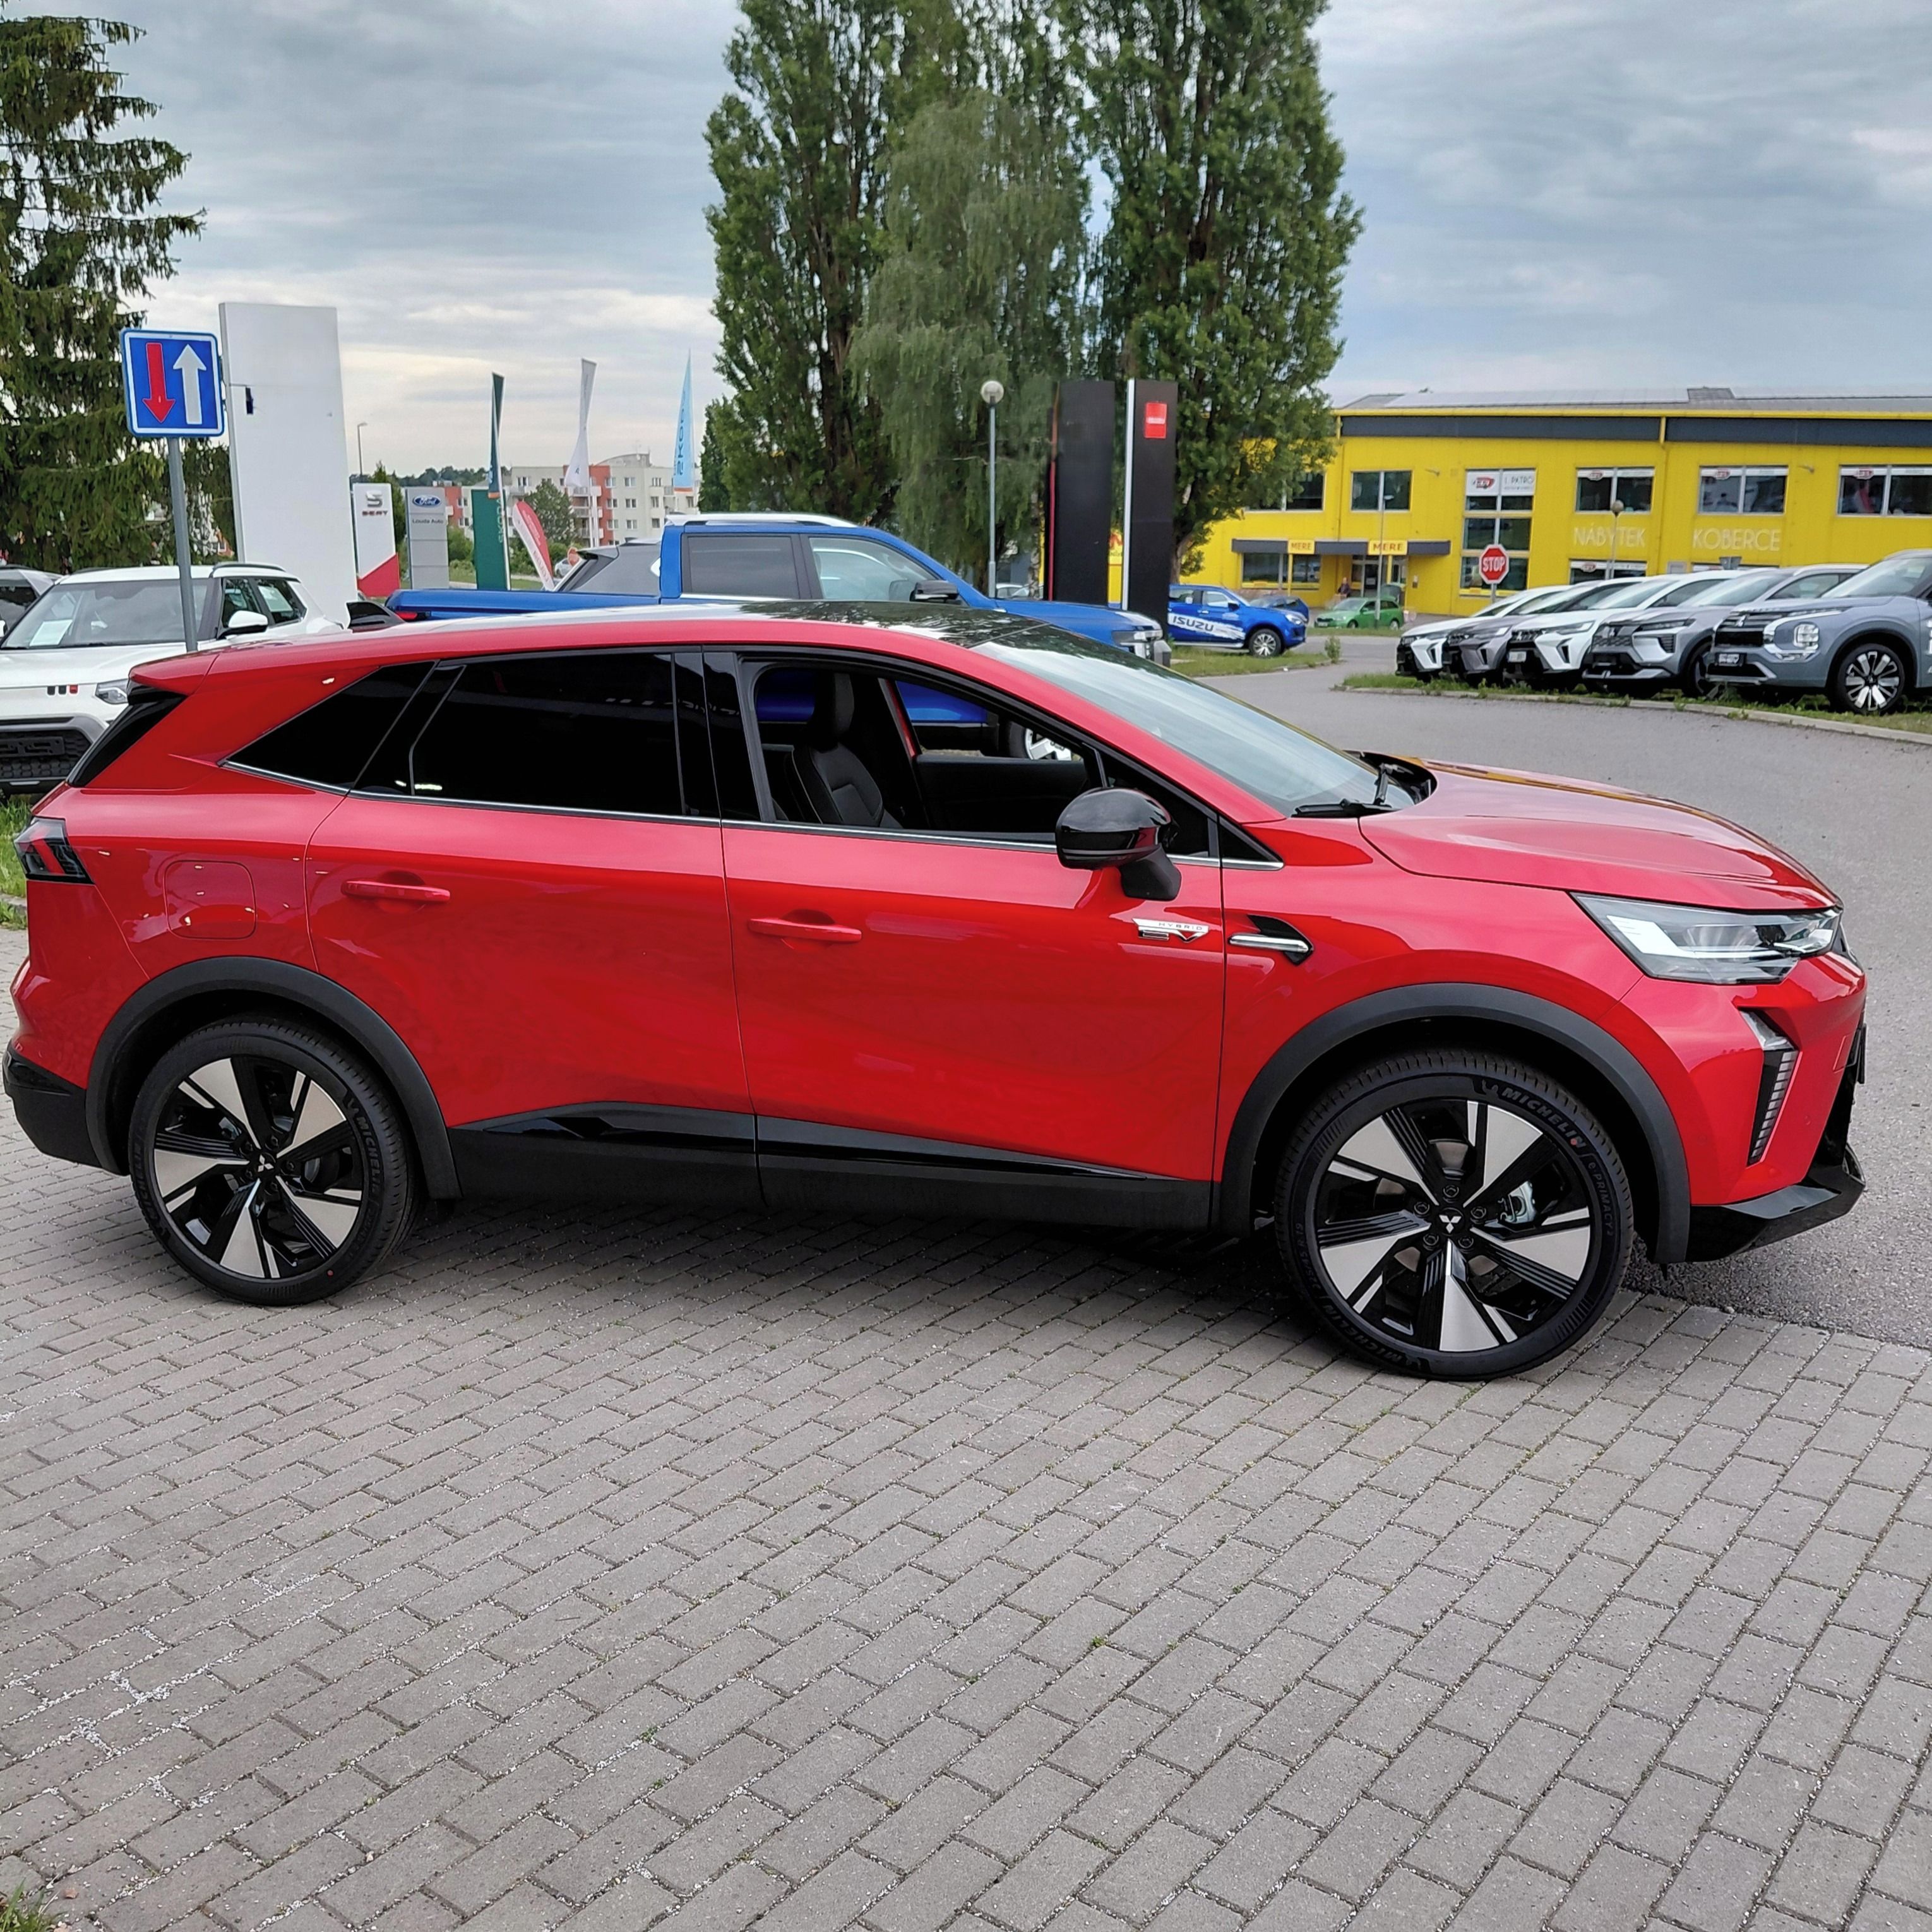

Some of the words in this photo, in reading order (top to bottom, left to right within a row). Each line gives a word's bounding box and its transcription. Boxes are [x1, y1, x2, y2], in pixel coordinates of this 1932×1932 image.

[417, 496, 439, 506] Ford
[1573, 523, 1647, 548] NÁBYTEK
[1692, 527, 1782, 552] KOBERCE
[1291, 542, 1312, 551] MERE
[1373, 542, 1403, 552] MERE
[1482, 556, 1506, 573] STOP
[1172, 616, 1214, 632] ISUZU
[1159, 922, 1203, 931] HYBRID
[1501, 1087, 1587, 1149] MICHELIN
[1323, 1301, 1403, 1362] MICHELIN
